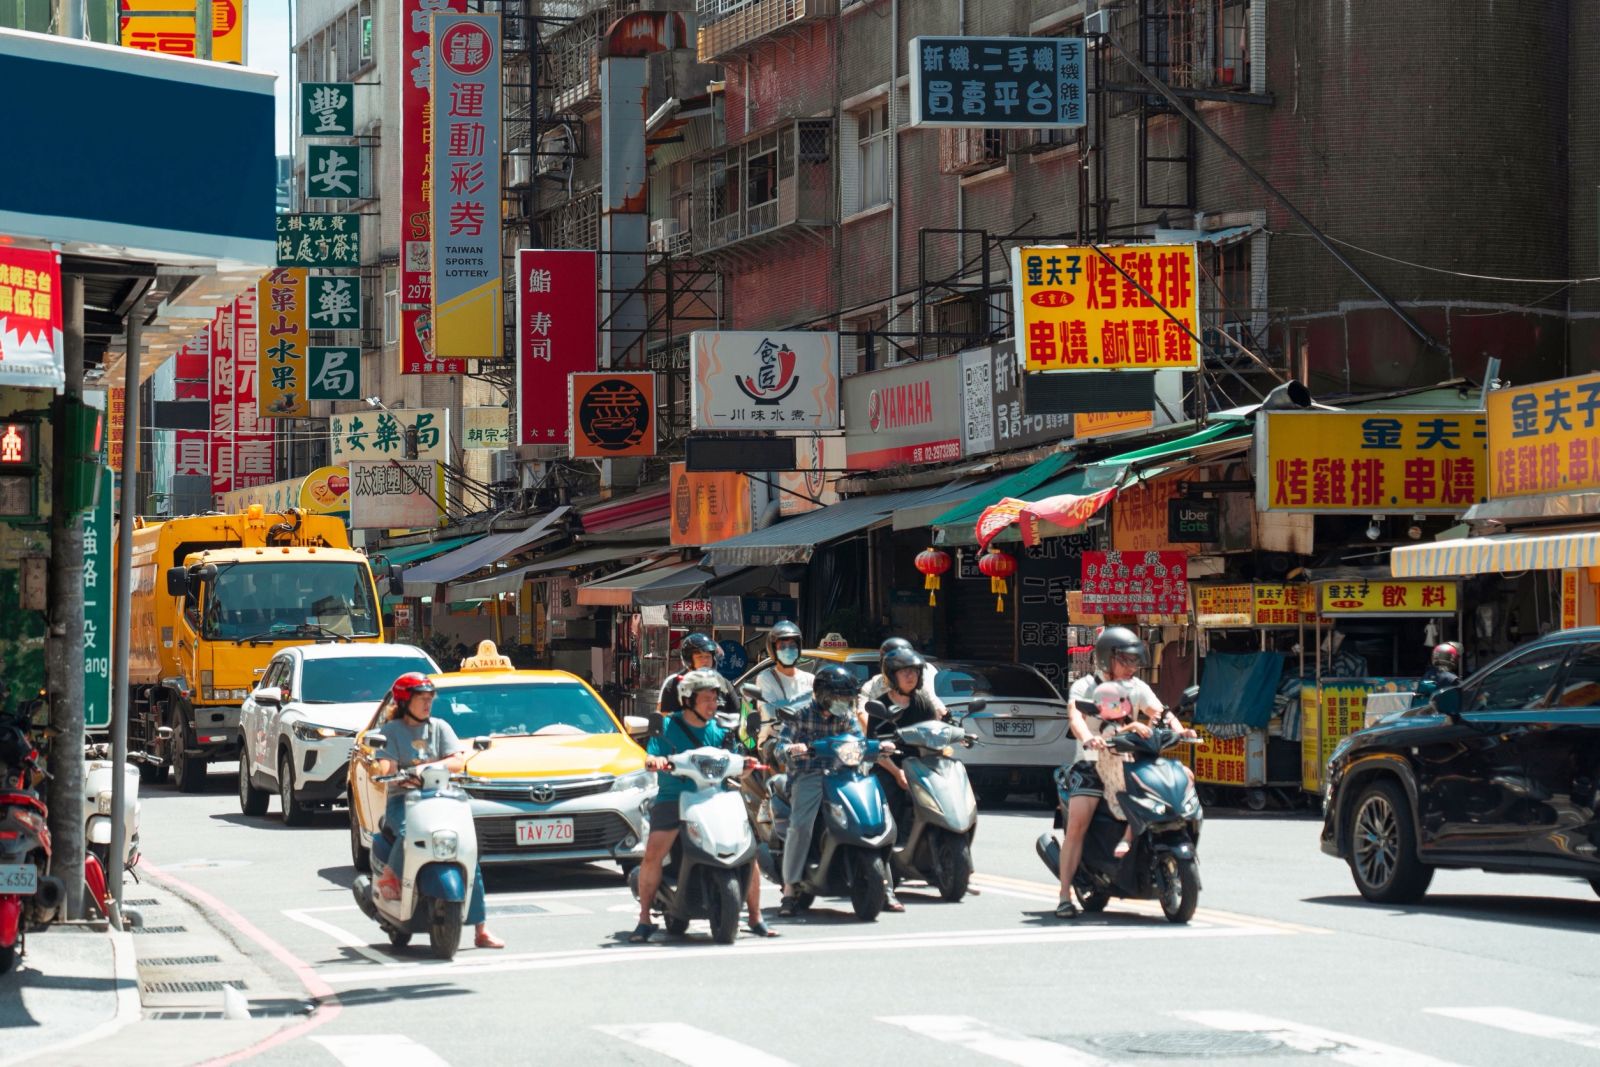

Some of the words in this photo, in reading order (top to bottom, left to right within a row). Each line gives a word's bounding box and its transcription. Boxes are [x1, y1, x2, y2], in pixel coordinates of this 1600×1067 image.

[1060, 43, 1080, 120] 手機維修
[928, 80, 1053, 116] 買賣平台
[448, 82, 486, 236] 運動彩券
[445, 246, 484, 254] TAIWAN
[445, 258, 484, 266] SPORTS
[445, 270, 489, 278] LOTTERY
[1027, 255, 1082, 286] 金夫子
[1086, 251, 1192, 310] 烤雞排
[881, 380, 933, 430] YAMAHA
[355, 465, 433, 497] 太源塑膠行
[1179, 509, 1209, 521] Uber
[1179, 521, 1209, 532] Eats
[1382, 585, 1447, 607] 飲料
[479, 659, 498, 667] TAXI
